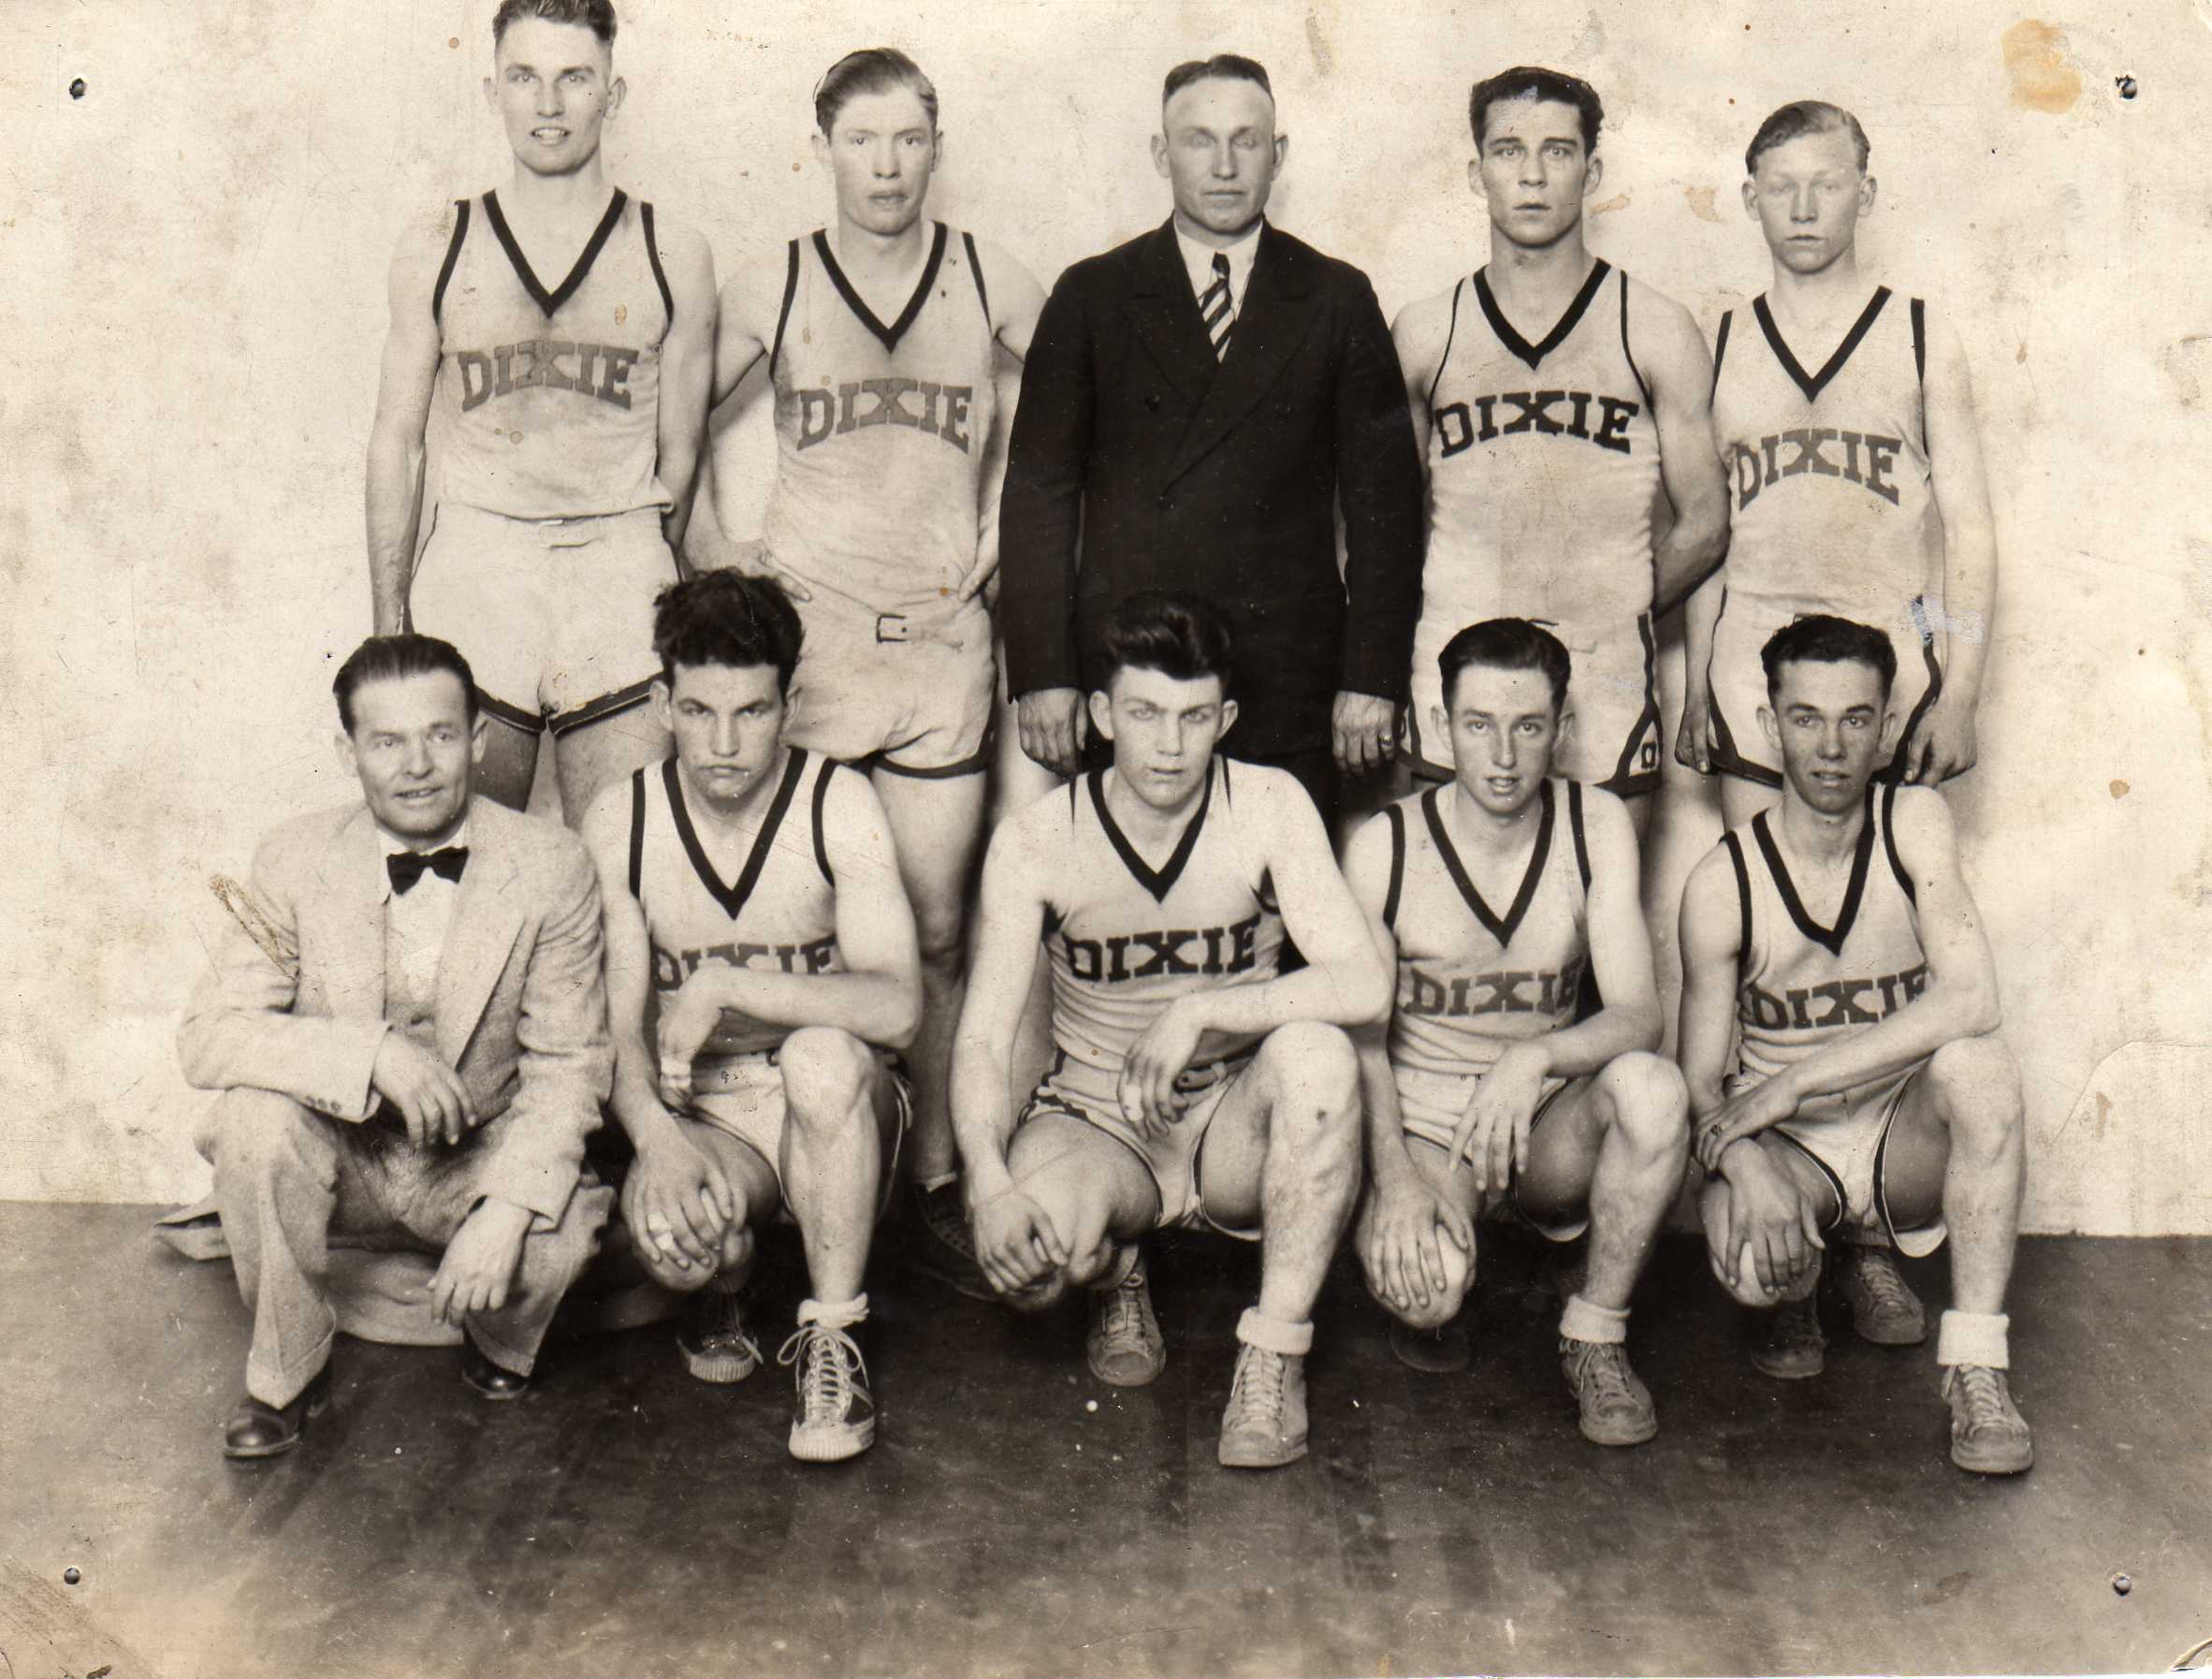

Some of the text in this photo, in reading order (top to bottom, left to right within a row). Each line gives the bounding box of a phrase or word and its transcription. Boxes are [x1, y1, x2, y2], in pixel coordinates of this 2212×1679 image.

[457, 340, 639, 413] DIXIE
[797, 378, 973, 455] DIXIE
[1433, 389, 1639, 460] DIXIE
[1734, 429, 1902, 512] DIXIE
[1065, 914, 1260, 983] DIXIE
[1404, 957, 1581, 1015] DIXIE
